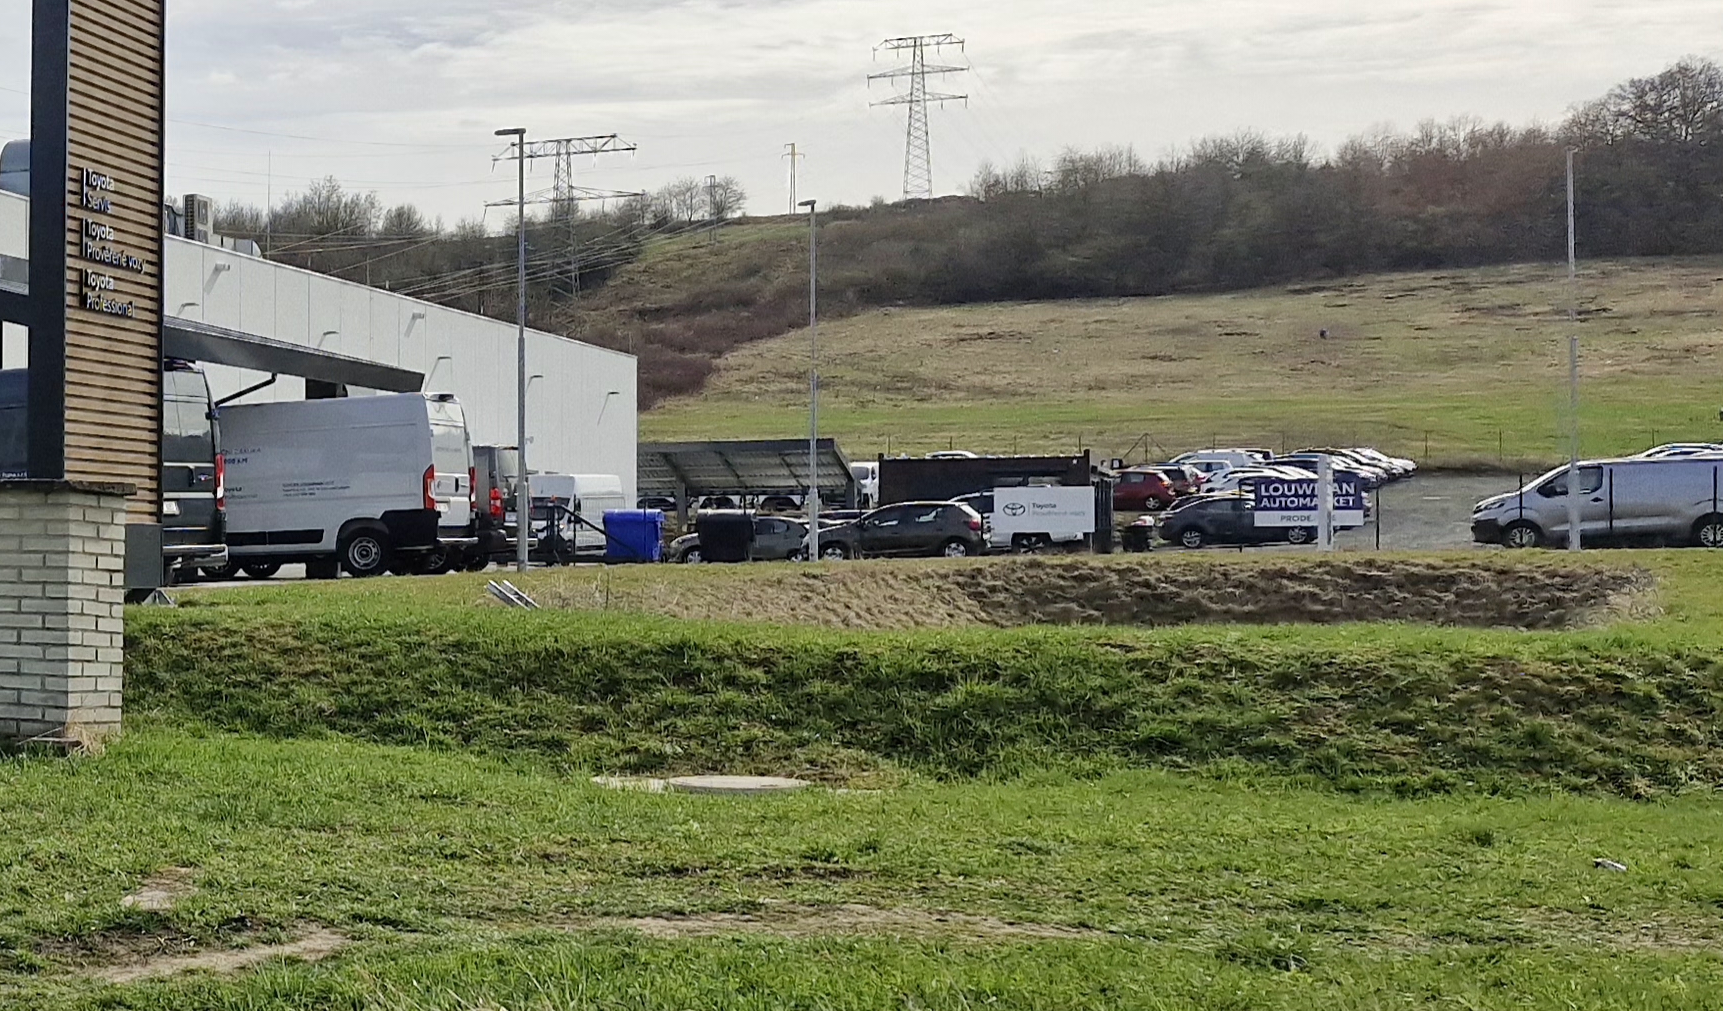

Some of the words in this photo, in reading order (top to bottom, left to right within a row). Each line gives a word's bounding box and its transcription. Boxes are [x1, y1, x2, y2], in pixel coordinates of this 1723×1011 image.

[87, 168, 115, 191] Toyota
[87, 191, 112, 214] Servis
[86, 218, 115, 241] Toyota
[128, 254, 147, 275] vozy
[86, 268, 115, 291] Toyota
[85, 291, 136, 319] Professional
[1260, 481, 1356, 496] LOUWAN
[1260, 496, 1356, 508] AUTOMAKET
